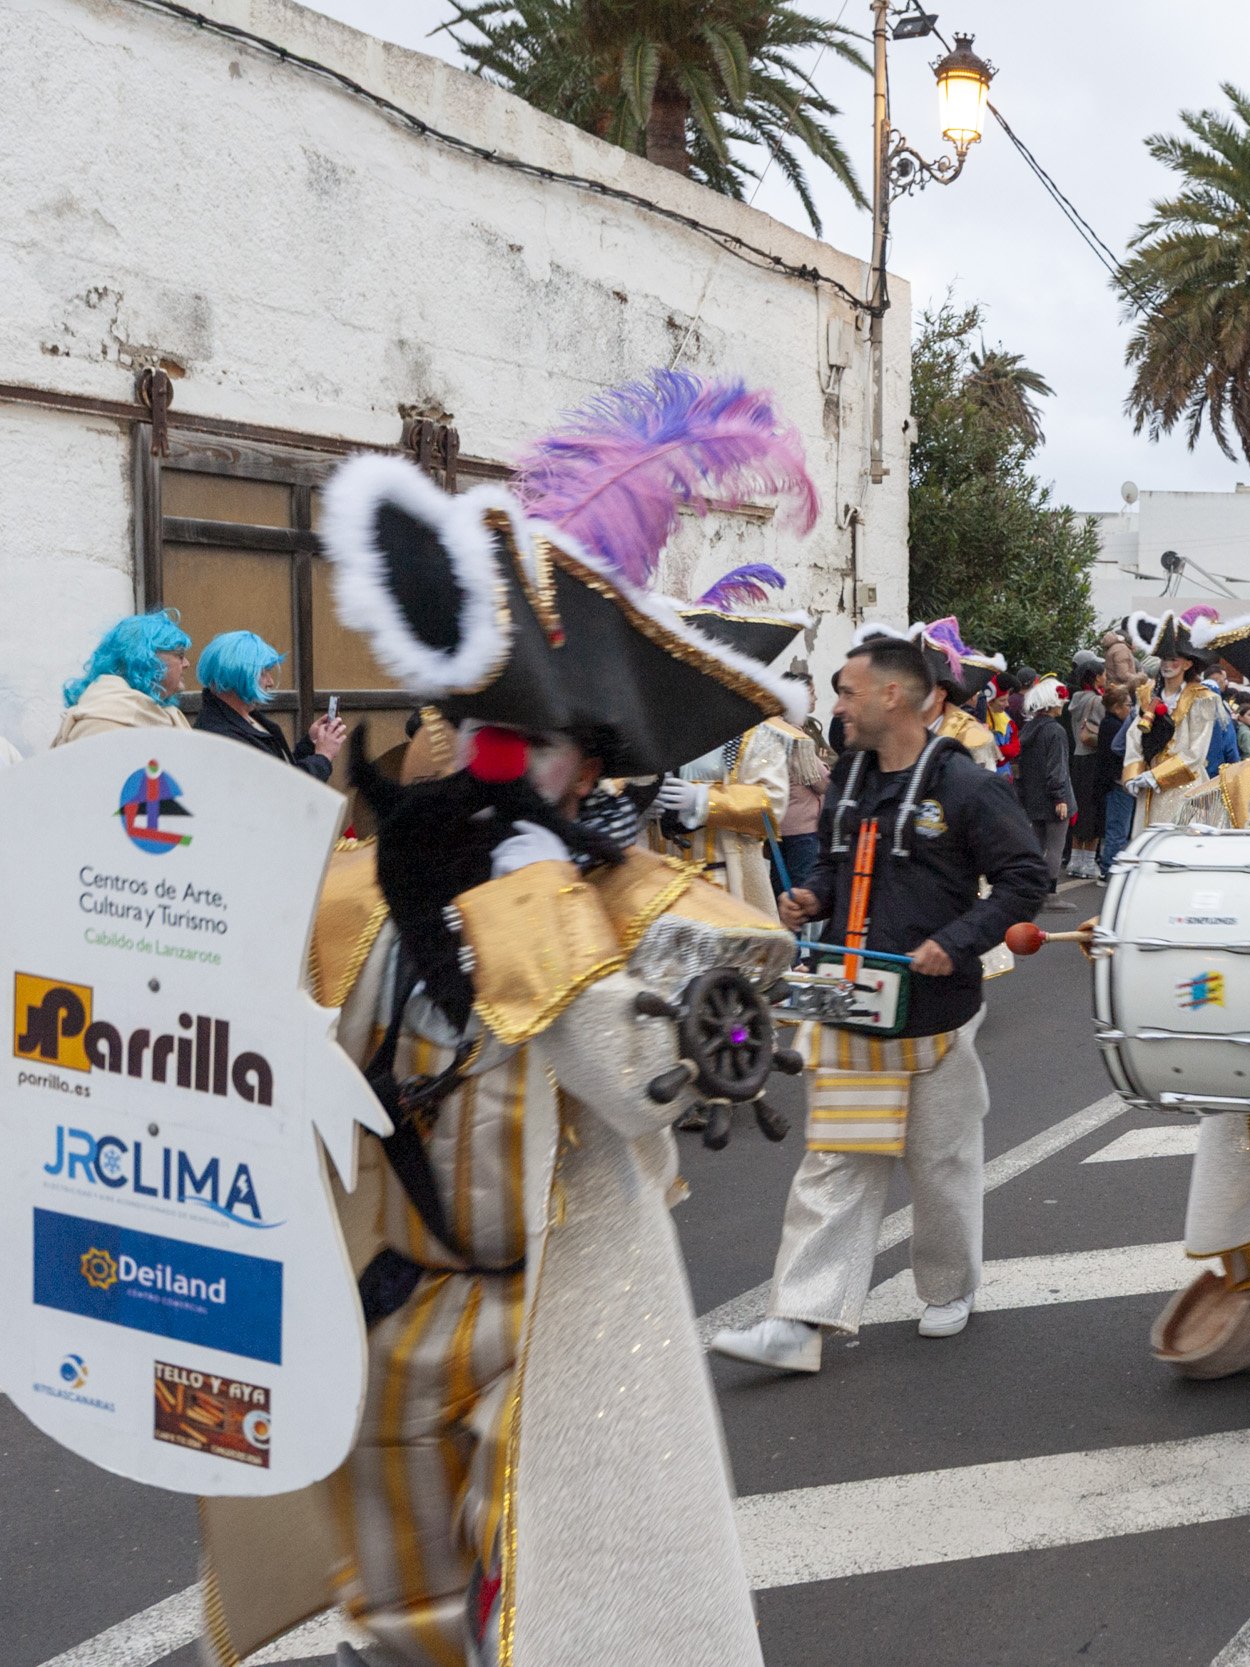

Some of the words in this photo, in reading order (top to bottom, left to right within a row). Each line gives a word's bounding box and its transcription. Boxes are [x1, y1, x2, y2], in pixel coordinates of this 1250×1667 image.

[79, 866, 148, 896] Centros
[155, 878, 177, 900] de
[182, 882, 228, 911] Arte,
[79, 892, 142, 921] Cultura
[145, 908, 155, 929] y
[158, 904, 228, 935] Turismo
[84, 927, 134, 950] Cabildo
[136, 936, 153, 953] de
[155, 940, 222, 965] Lanzarote
[18, 987, 273, 1107] Parrilla
[18, 1071, 91, 1098] parrilla.es
[44, 1125, 262, 1220] JRCLIMA
[119, 1254, 226, 1305] Deiland
[155, 1363, 204, 1389] TELLO
[210, 1375, 223, 1395] Y
[229, 1383, 266, 1405] AYA
